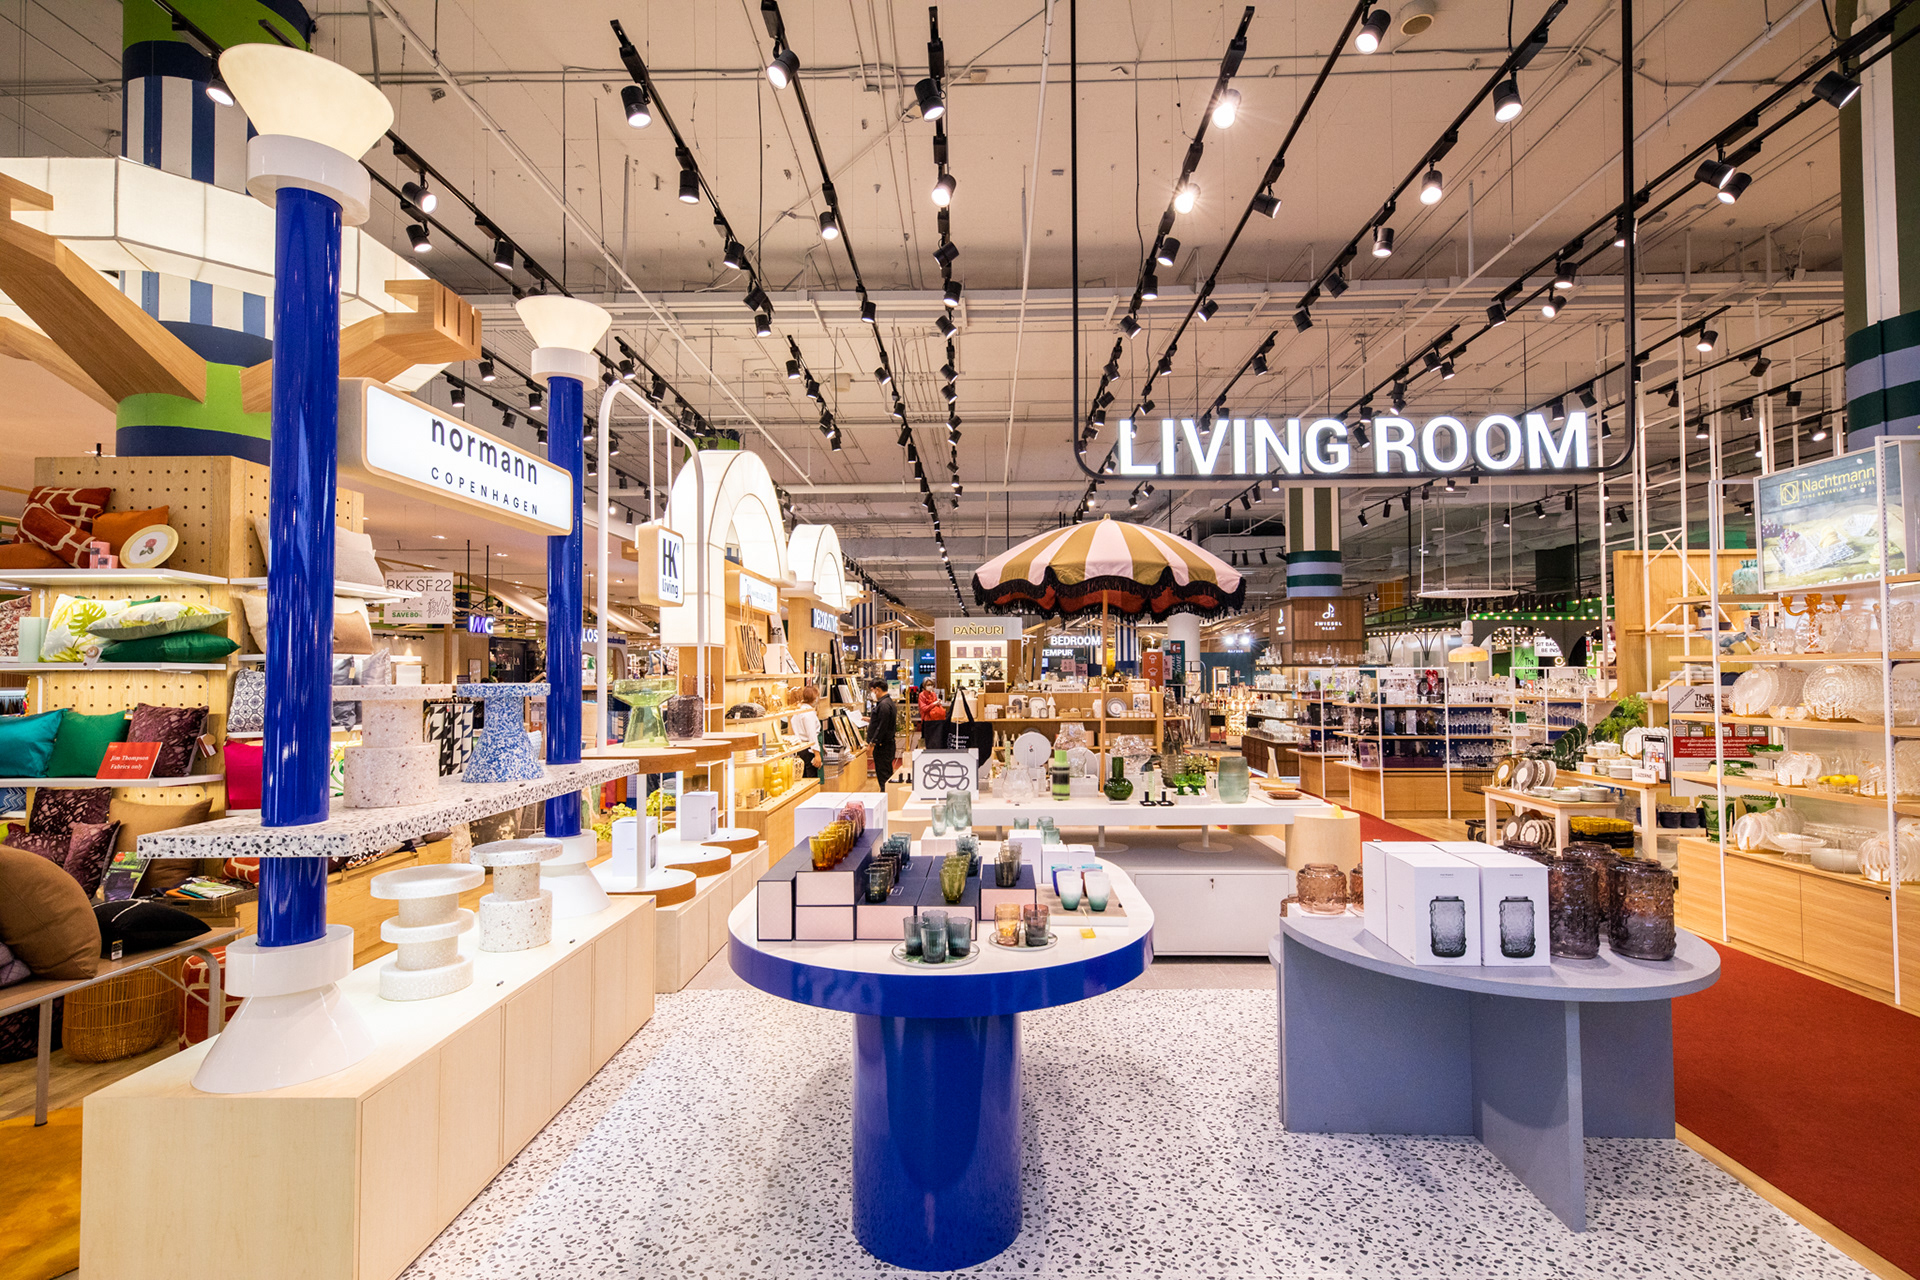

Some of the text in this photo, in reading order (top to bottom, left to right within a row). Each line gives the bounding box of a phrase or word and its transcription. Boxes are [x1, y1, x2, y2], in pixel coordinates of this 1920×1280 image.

[431, 418, 538, 485] normann
[1118, 411, 1590, 475] LIVING ROOM
[1801, 466, 1876, 494] Nachtmann
[431, 467, 538, 515] COPENHAGEN
[662, 538, 679, 579] HK
[953, 622, 1005, 636] PAÑPURI
[1050, 635, 1101, 646] BEDROOM
[1042, 648, 1074, 657] TEMPUR
[1524, 657, 1534, 665] The
[131, 763, 143, 771] only
